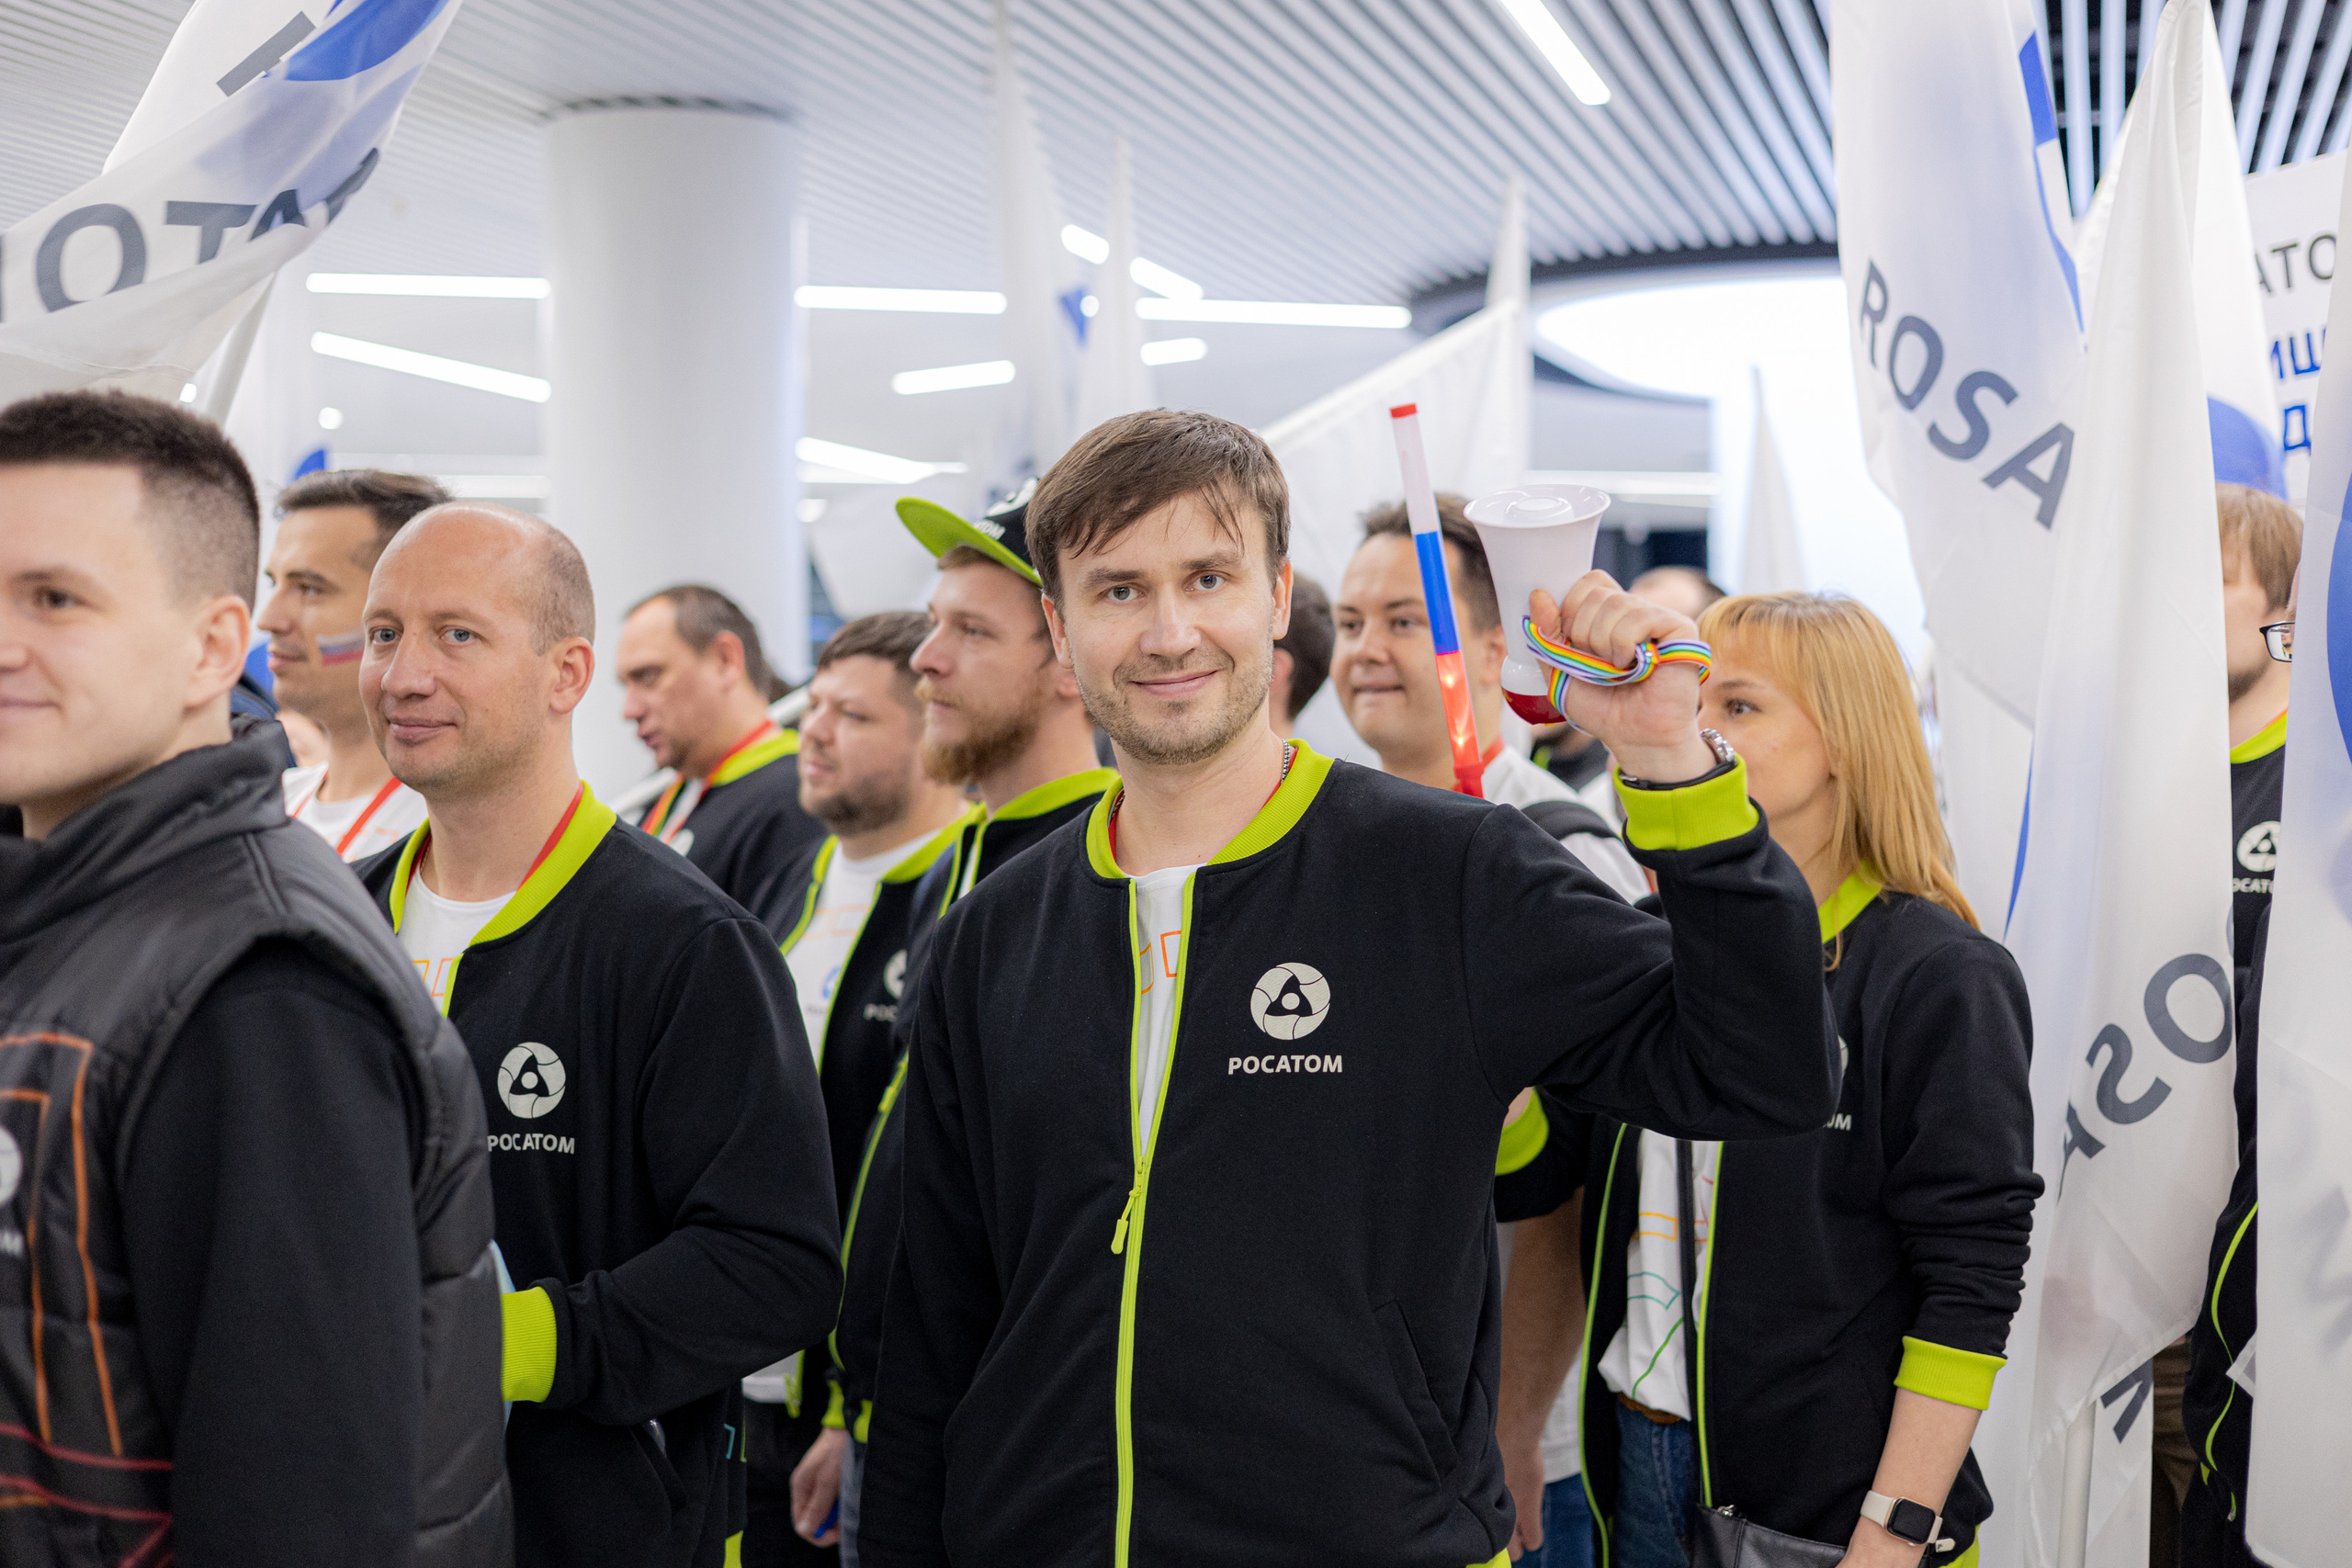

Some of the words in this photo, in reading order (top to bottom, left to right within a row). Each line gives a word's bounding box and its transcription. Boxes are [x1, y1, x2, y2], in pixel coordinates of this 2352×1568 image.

[1860, 259, 2075, 531] ROSA
[1227, 1054, 1343, 1076] РОСАТОМ
[486, 1133, 575, 1155] РОСАТОМ
